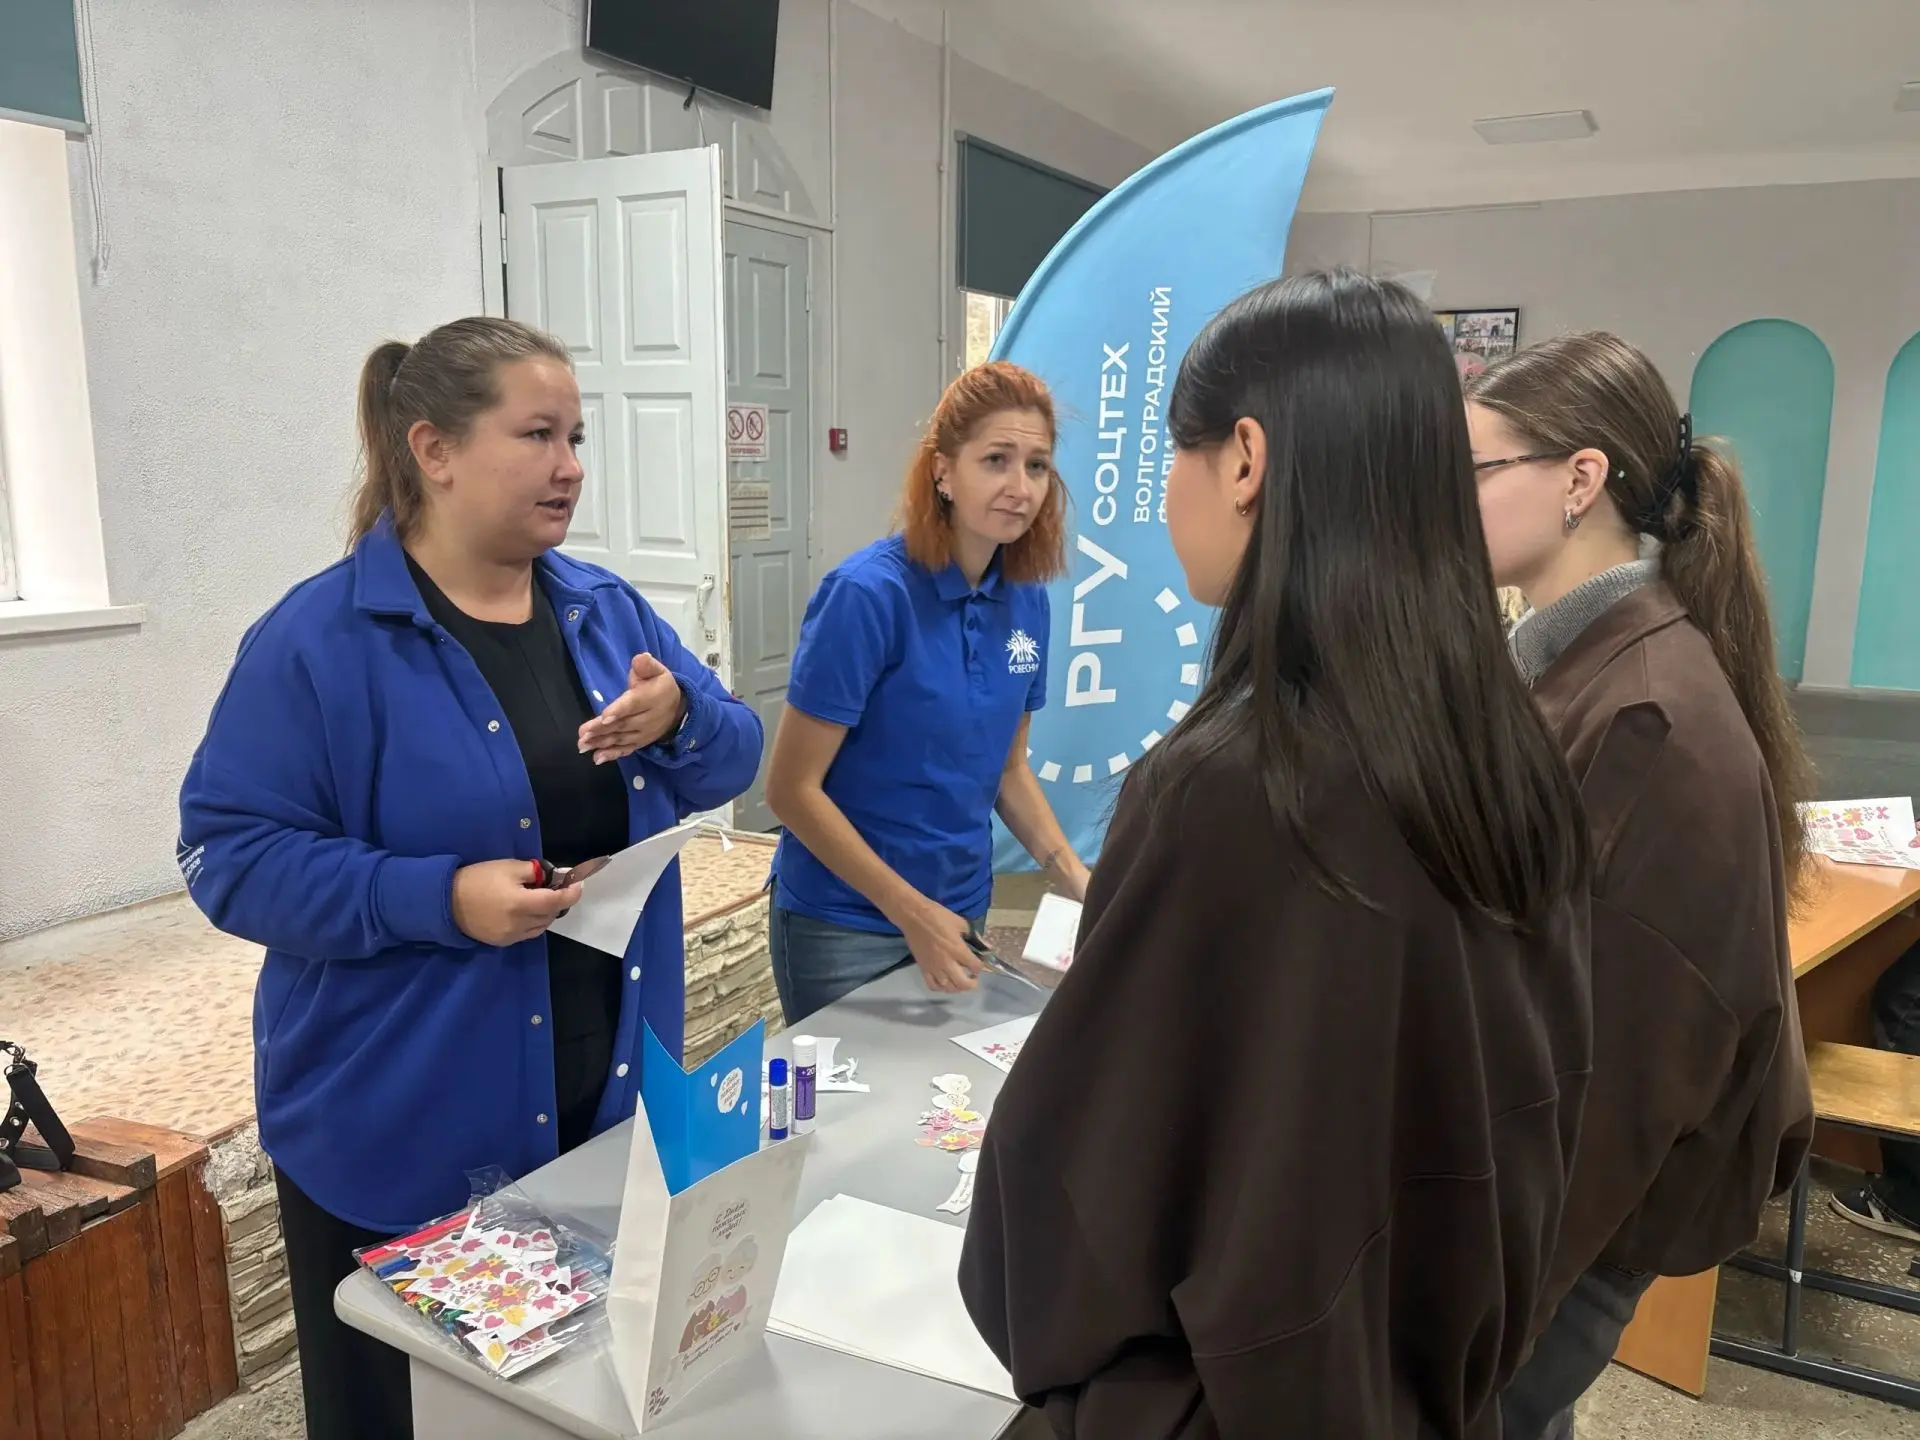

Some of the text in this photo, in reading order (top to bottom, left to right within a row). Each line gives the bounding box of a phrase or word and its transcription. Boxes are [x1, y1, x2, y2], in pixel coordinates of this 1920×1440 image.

[1065, 342, 1130, 706] РГУ СОЦТЕХ
[1133, 287, 1172, 523] ВОЛГОГРАДСКИЙ
